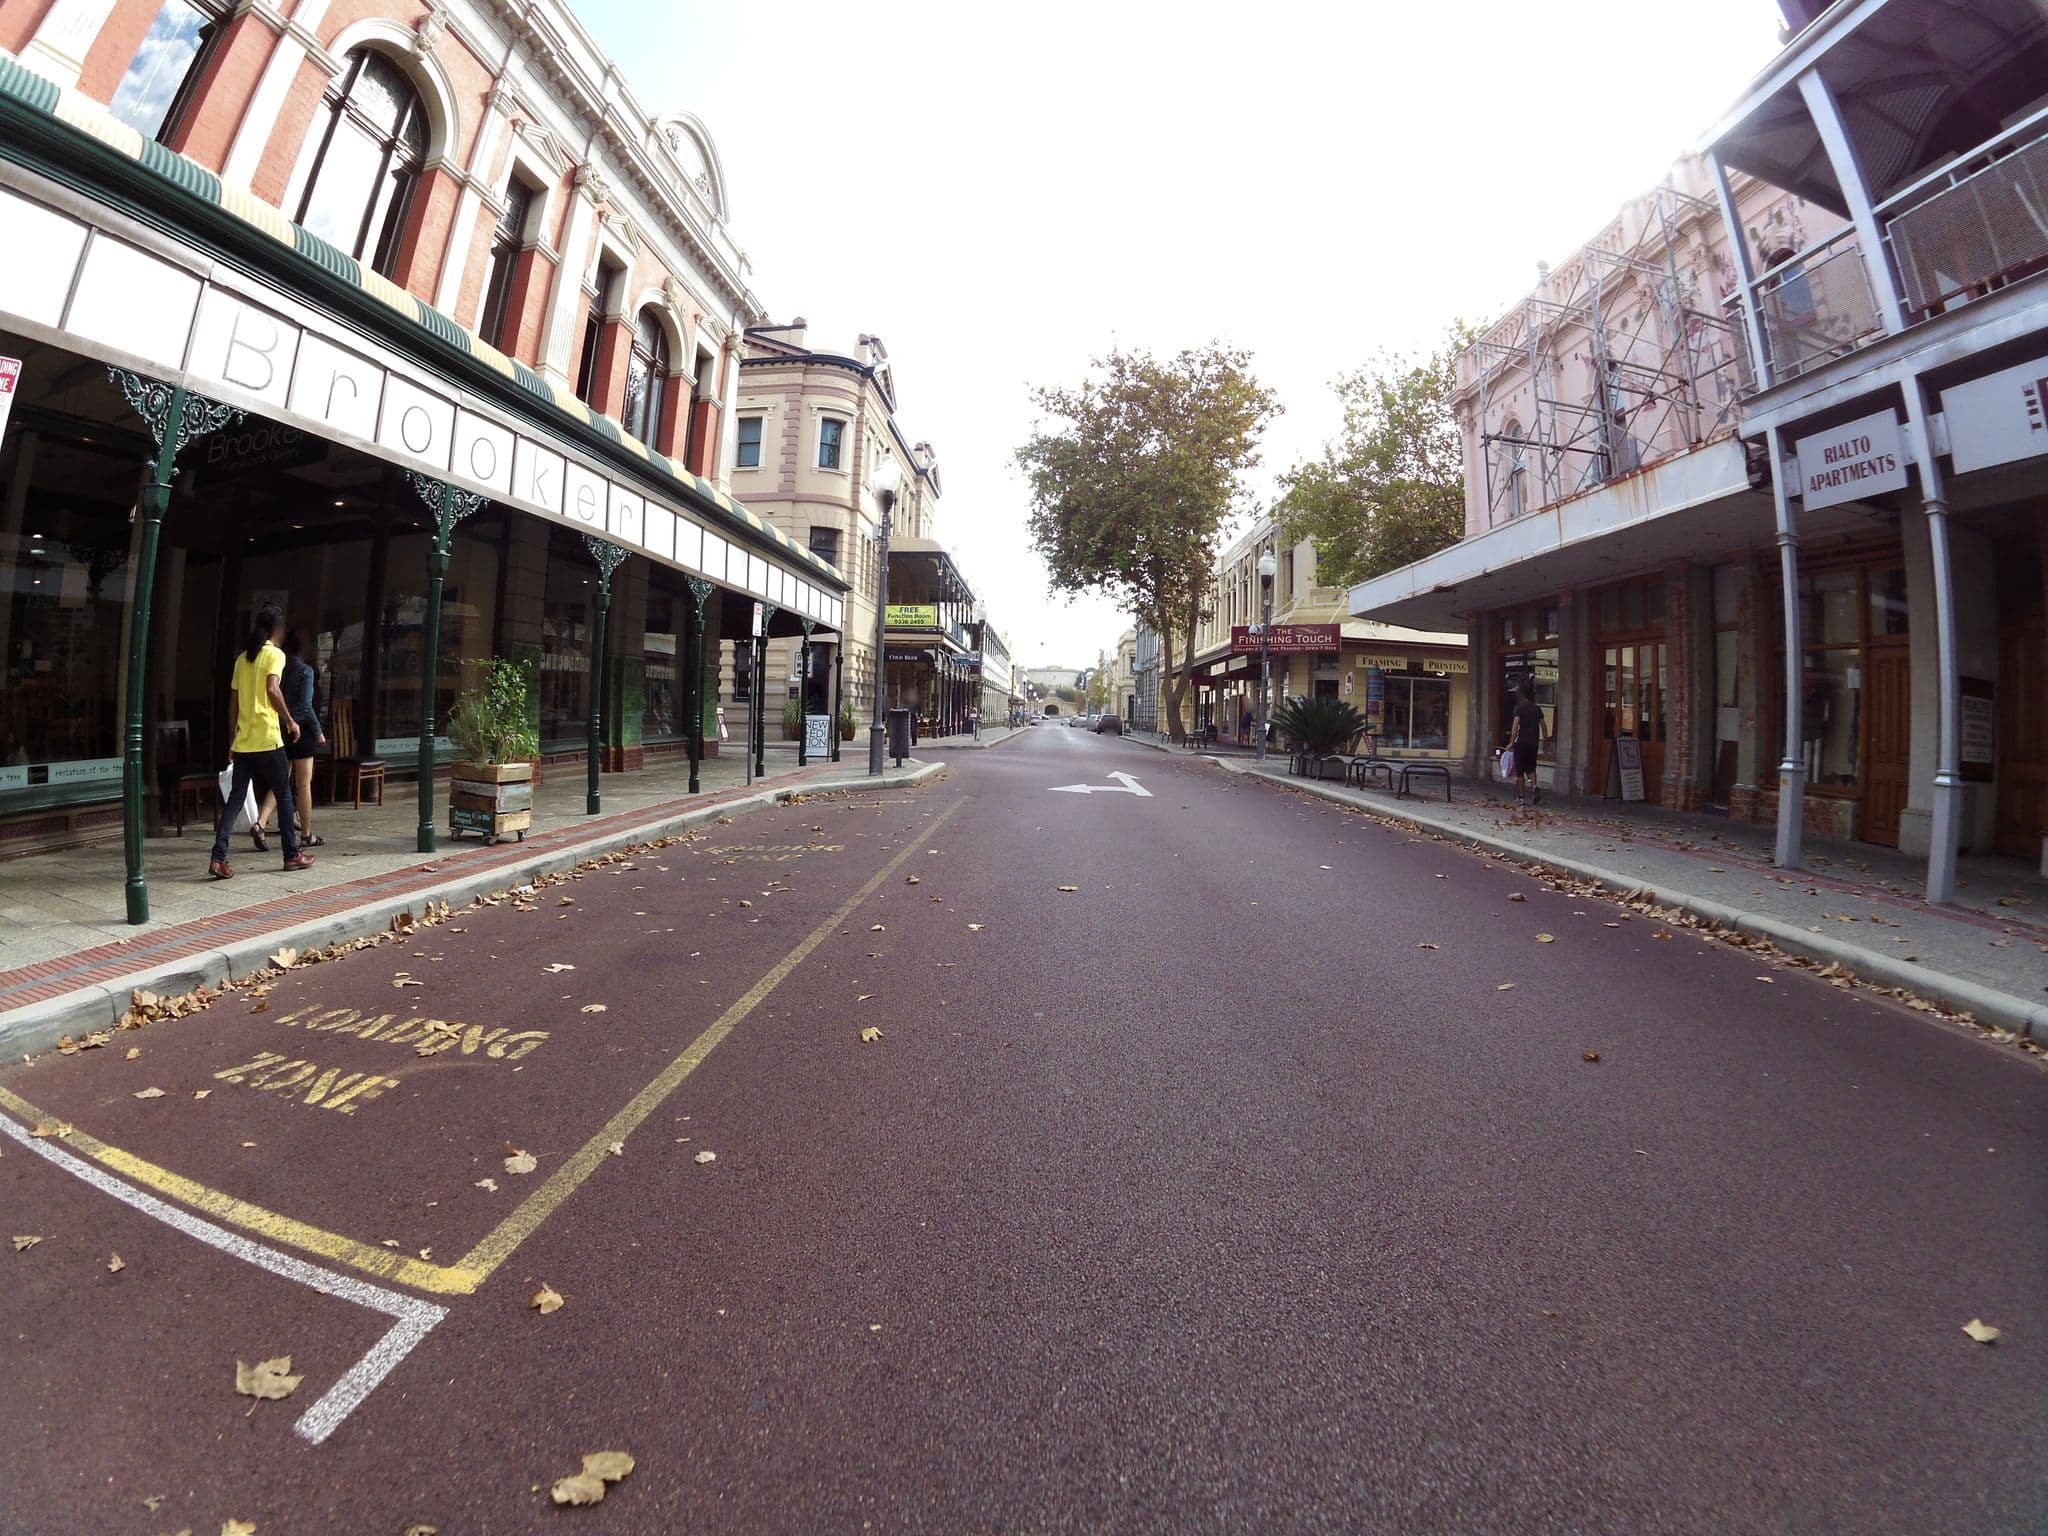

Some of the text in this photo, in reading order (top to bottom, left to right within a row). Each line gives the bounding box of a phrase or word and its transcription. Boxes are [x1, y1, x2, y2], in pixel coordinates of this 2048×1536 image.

[0, 359, 18, 376] DING
[222, 305, 632, 535] Brooker
[1824, 435, 1871, 465] RIALTO
[1810, 453, 1896, 493] APARTMENTS
[1296, 634, 1332, 644] TOUCH
[1362, 656, 1401, 667] FRAMING
[1428, 660, 1467, 672] PRINTING
[806, 720, 828, 730] NEW
[273, 1003, 551, 1060] LOADING
[214, 1051, 400, 1116] ZONE
